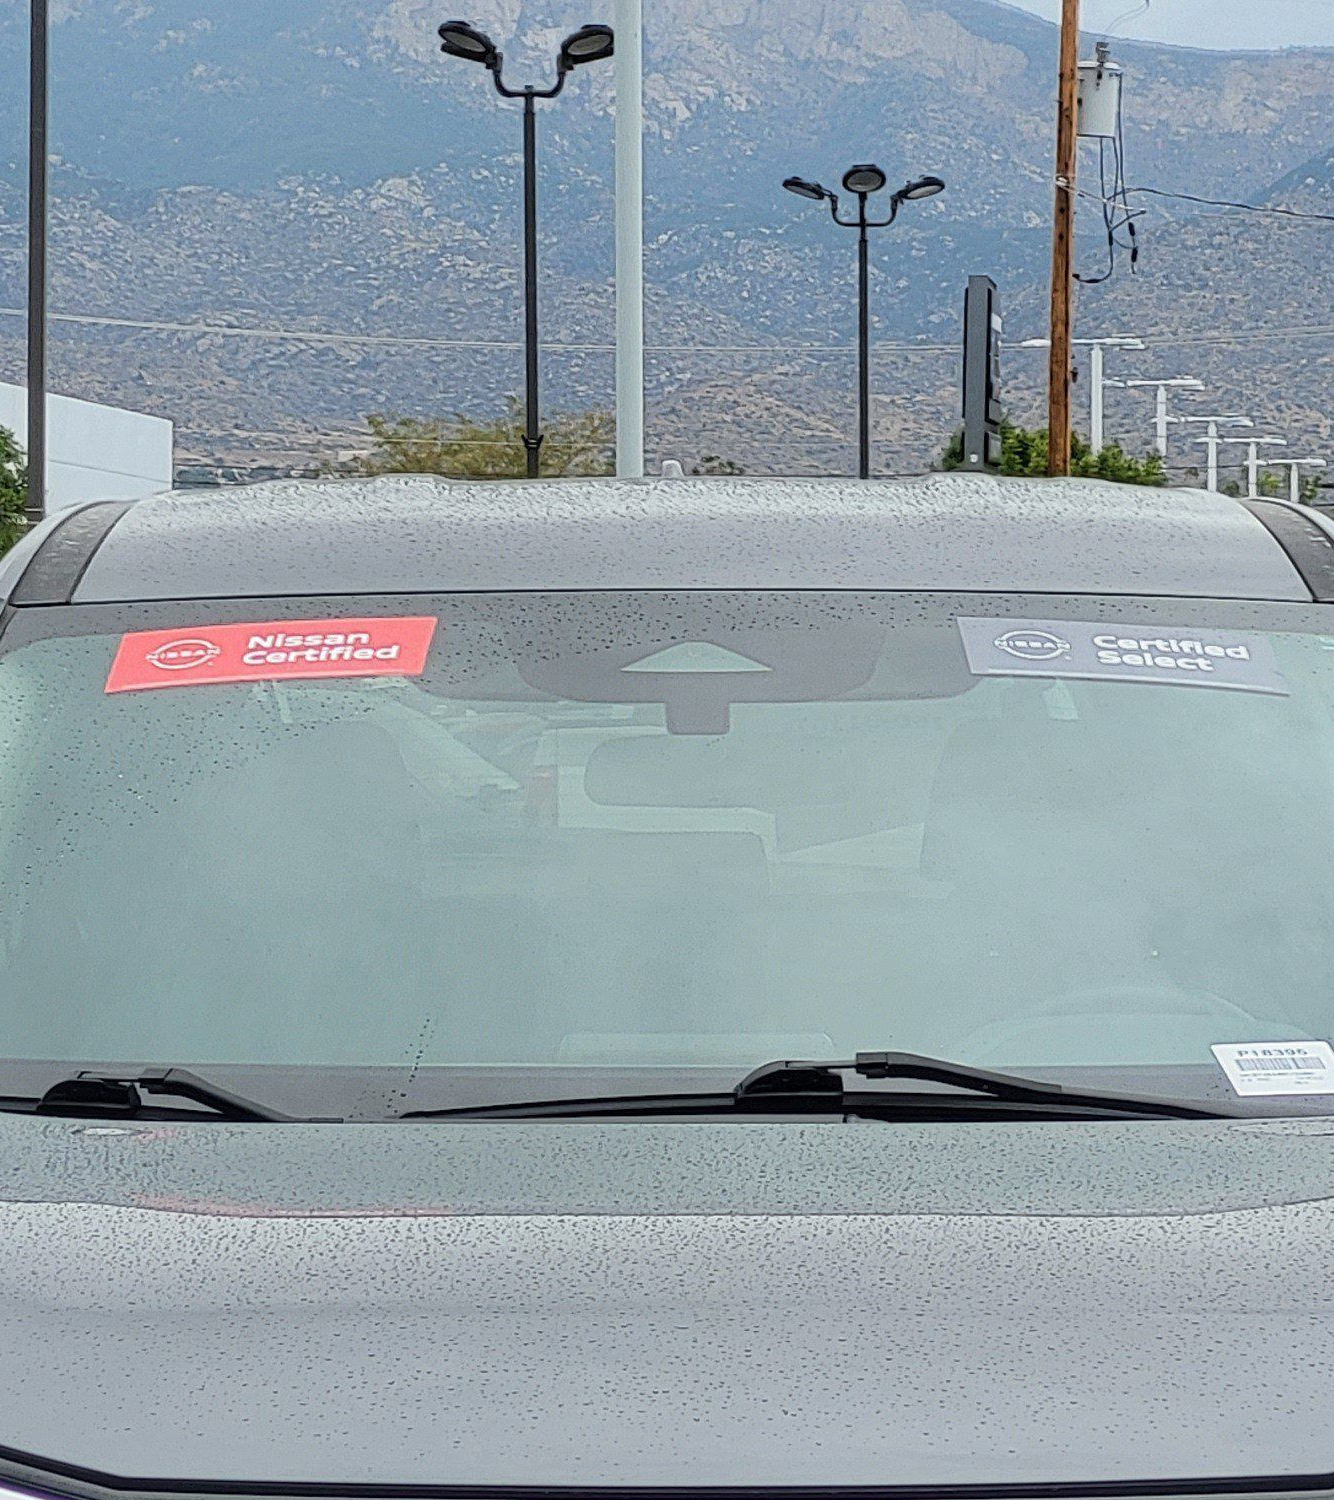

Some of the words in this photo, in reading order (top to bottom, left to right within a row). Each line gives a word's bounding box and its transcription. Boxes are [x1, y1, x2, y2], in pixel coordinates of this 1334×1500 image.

[247, 633, 371, 649] Nissan
[993, 636, 1072, 652] NISSAN
[1092, 635, 1251, 661] Certified
[145, 646, 222, 662] NISSAN
[241, 645, 400, 665] Certified
[1097, 650, 1215, 673] Select
